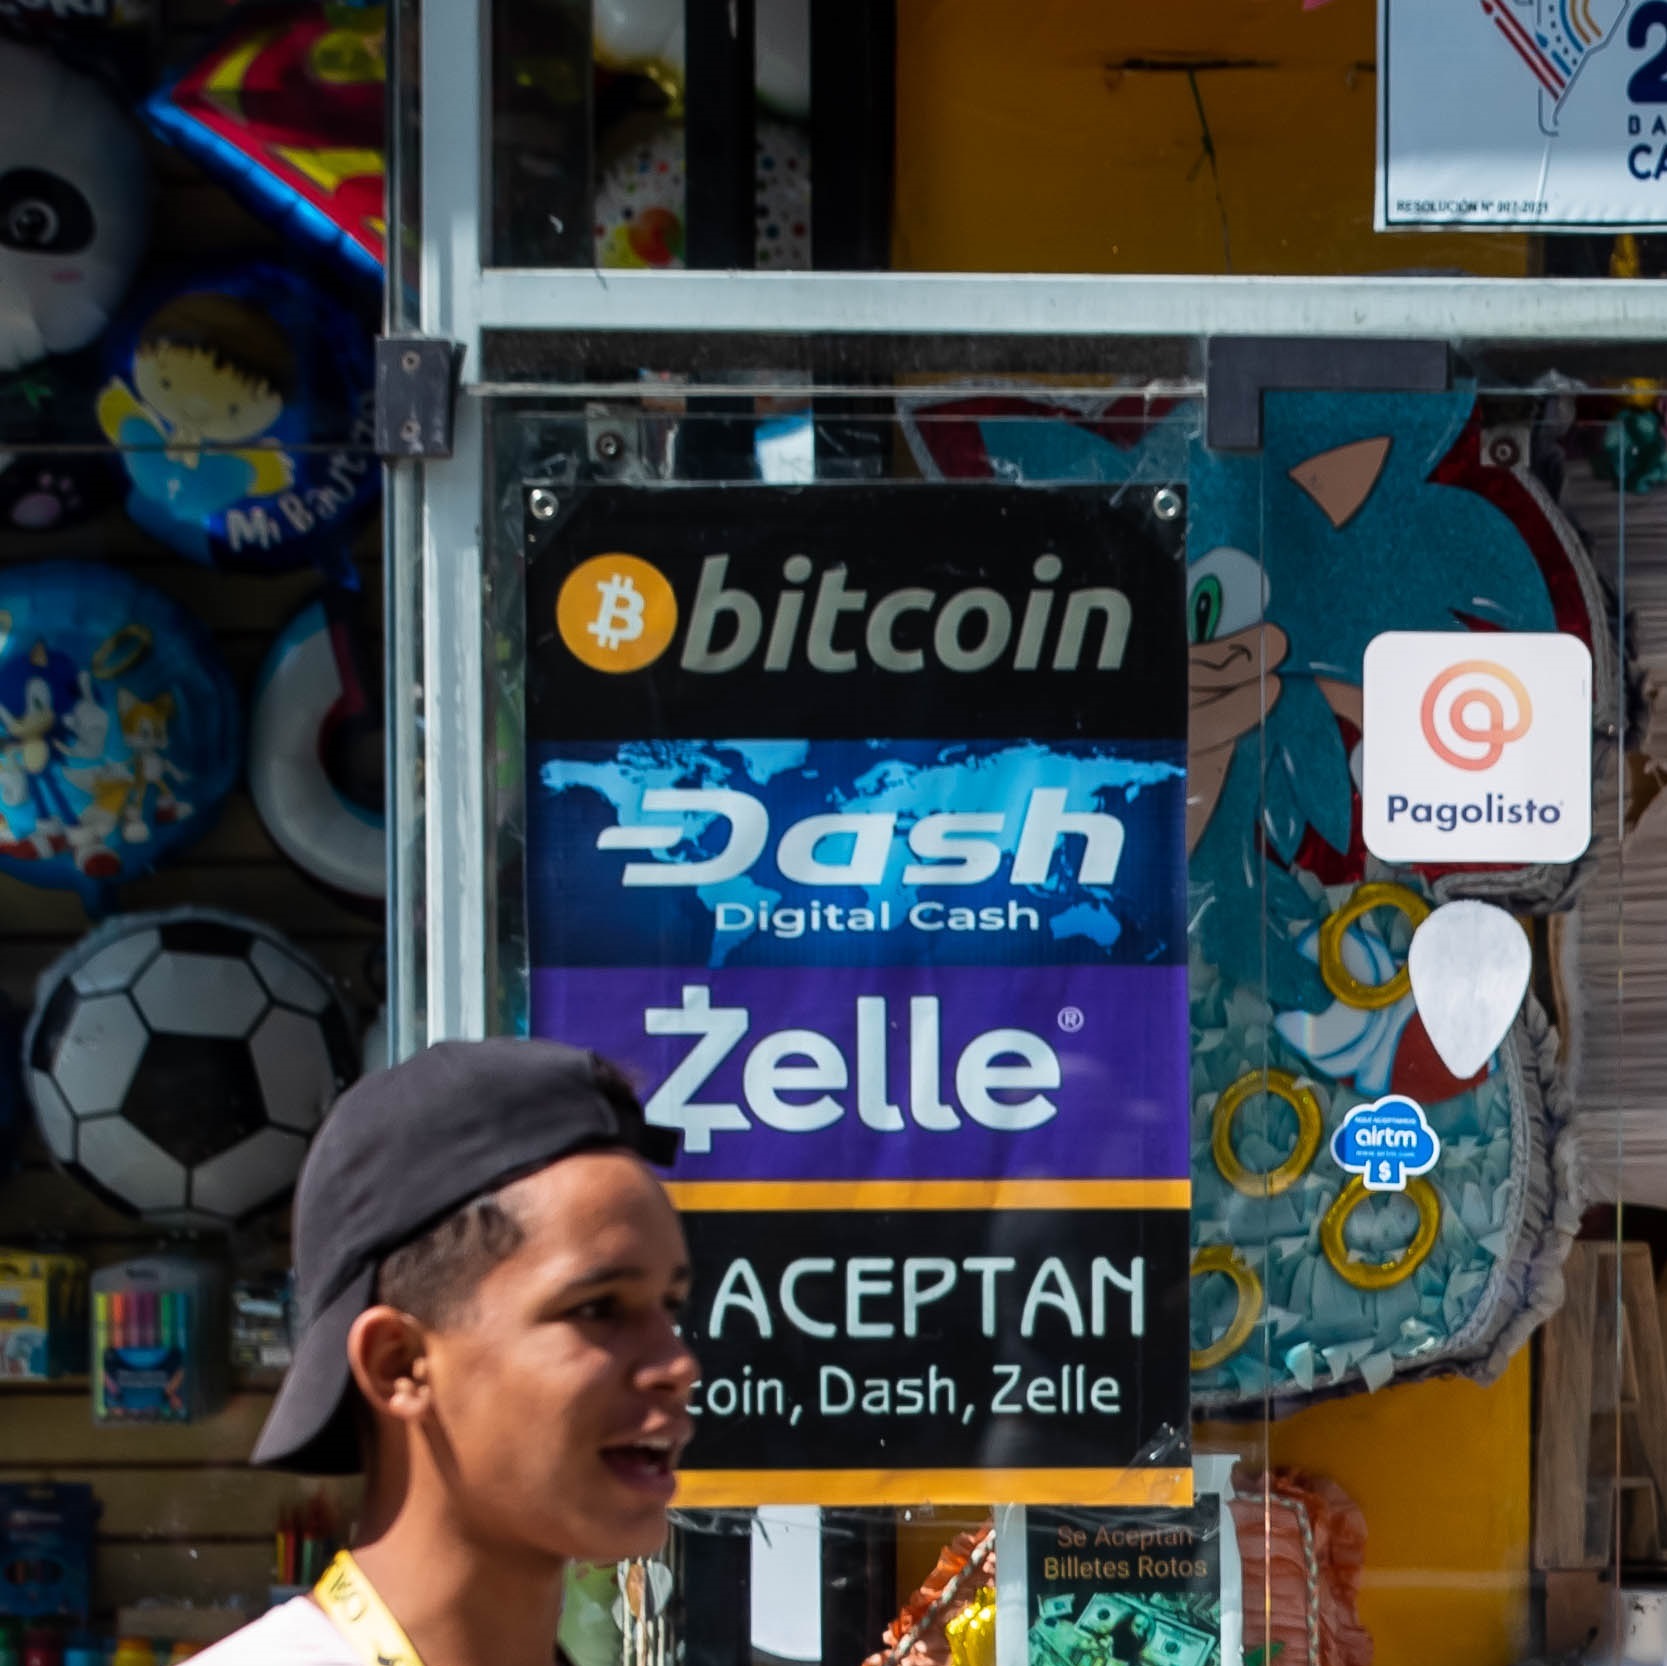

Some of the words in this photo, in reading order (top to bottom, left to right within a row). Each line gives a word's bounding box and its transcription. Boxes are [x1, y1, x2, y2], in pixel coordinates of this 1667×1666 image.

[680, 554, 1133, 672] bitcoin
[1387, 793, 1561, 832] Pagolisto
[597, 787, 1126, 887] Dash
[715, 901, 890, 938] Digital
[909, 901, 1040, 932] Cash
[1355, 1125, 1417, 1148] airtm
[709, 1256, 1145, 1339] ACEPTAN
[818, 1364, 976, 1424] Dash,
[990, 1364, 1121, 1415] Zelle
[1057, 1525, 1088, 1548] Se
[1094, 1525, 1193, 1552] Aceptan
[1044, 1555, 1131, 1580] Billetes
[1138, 1555, 1208, 1579] Rotos
